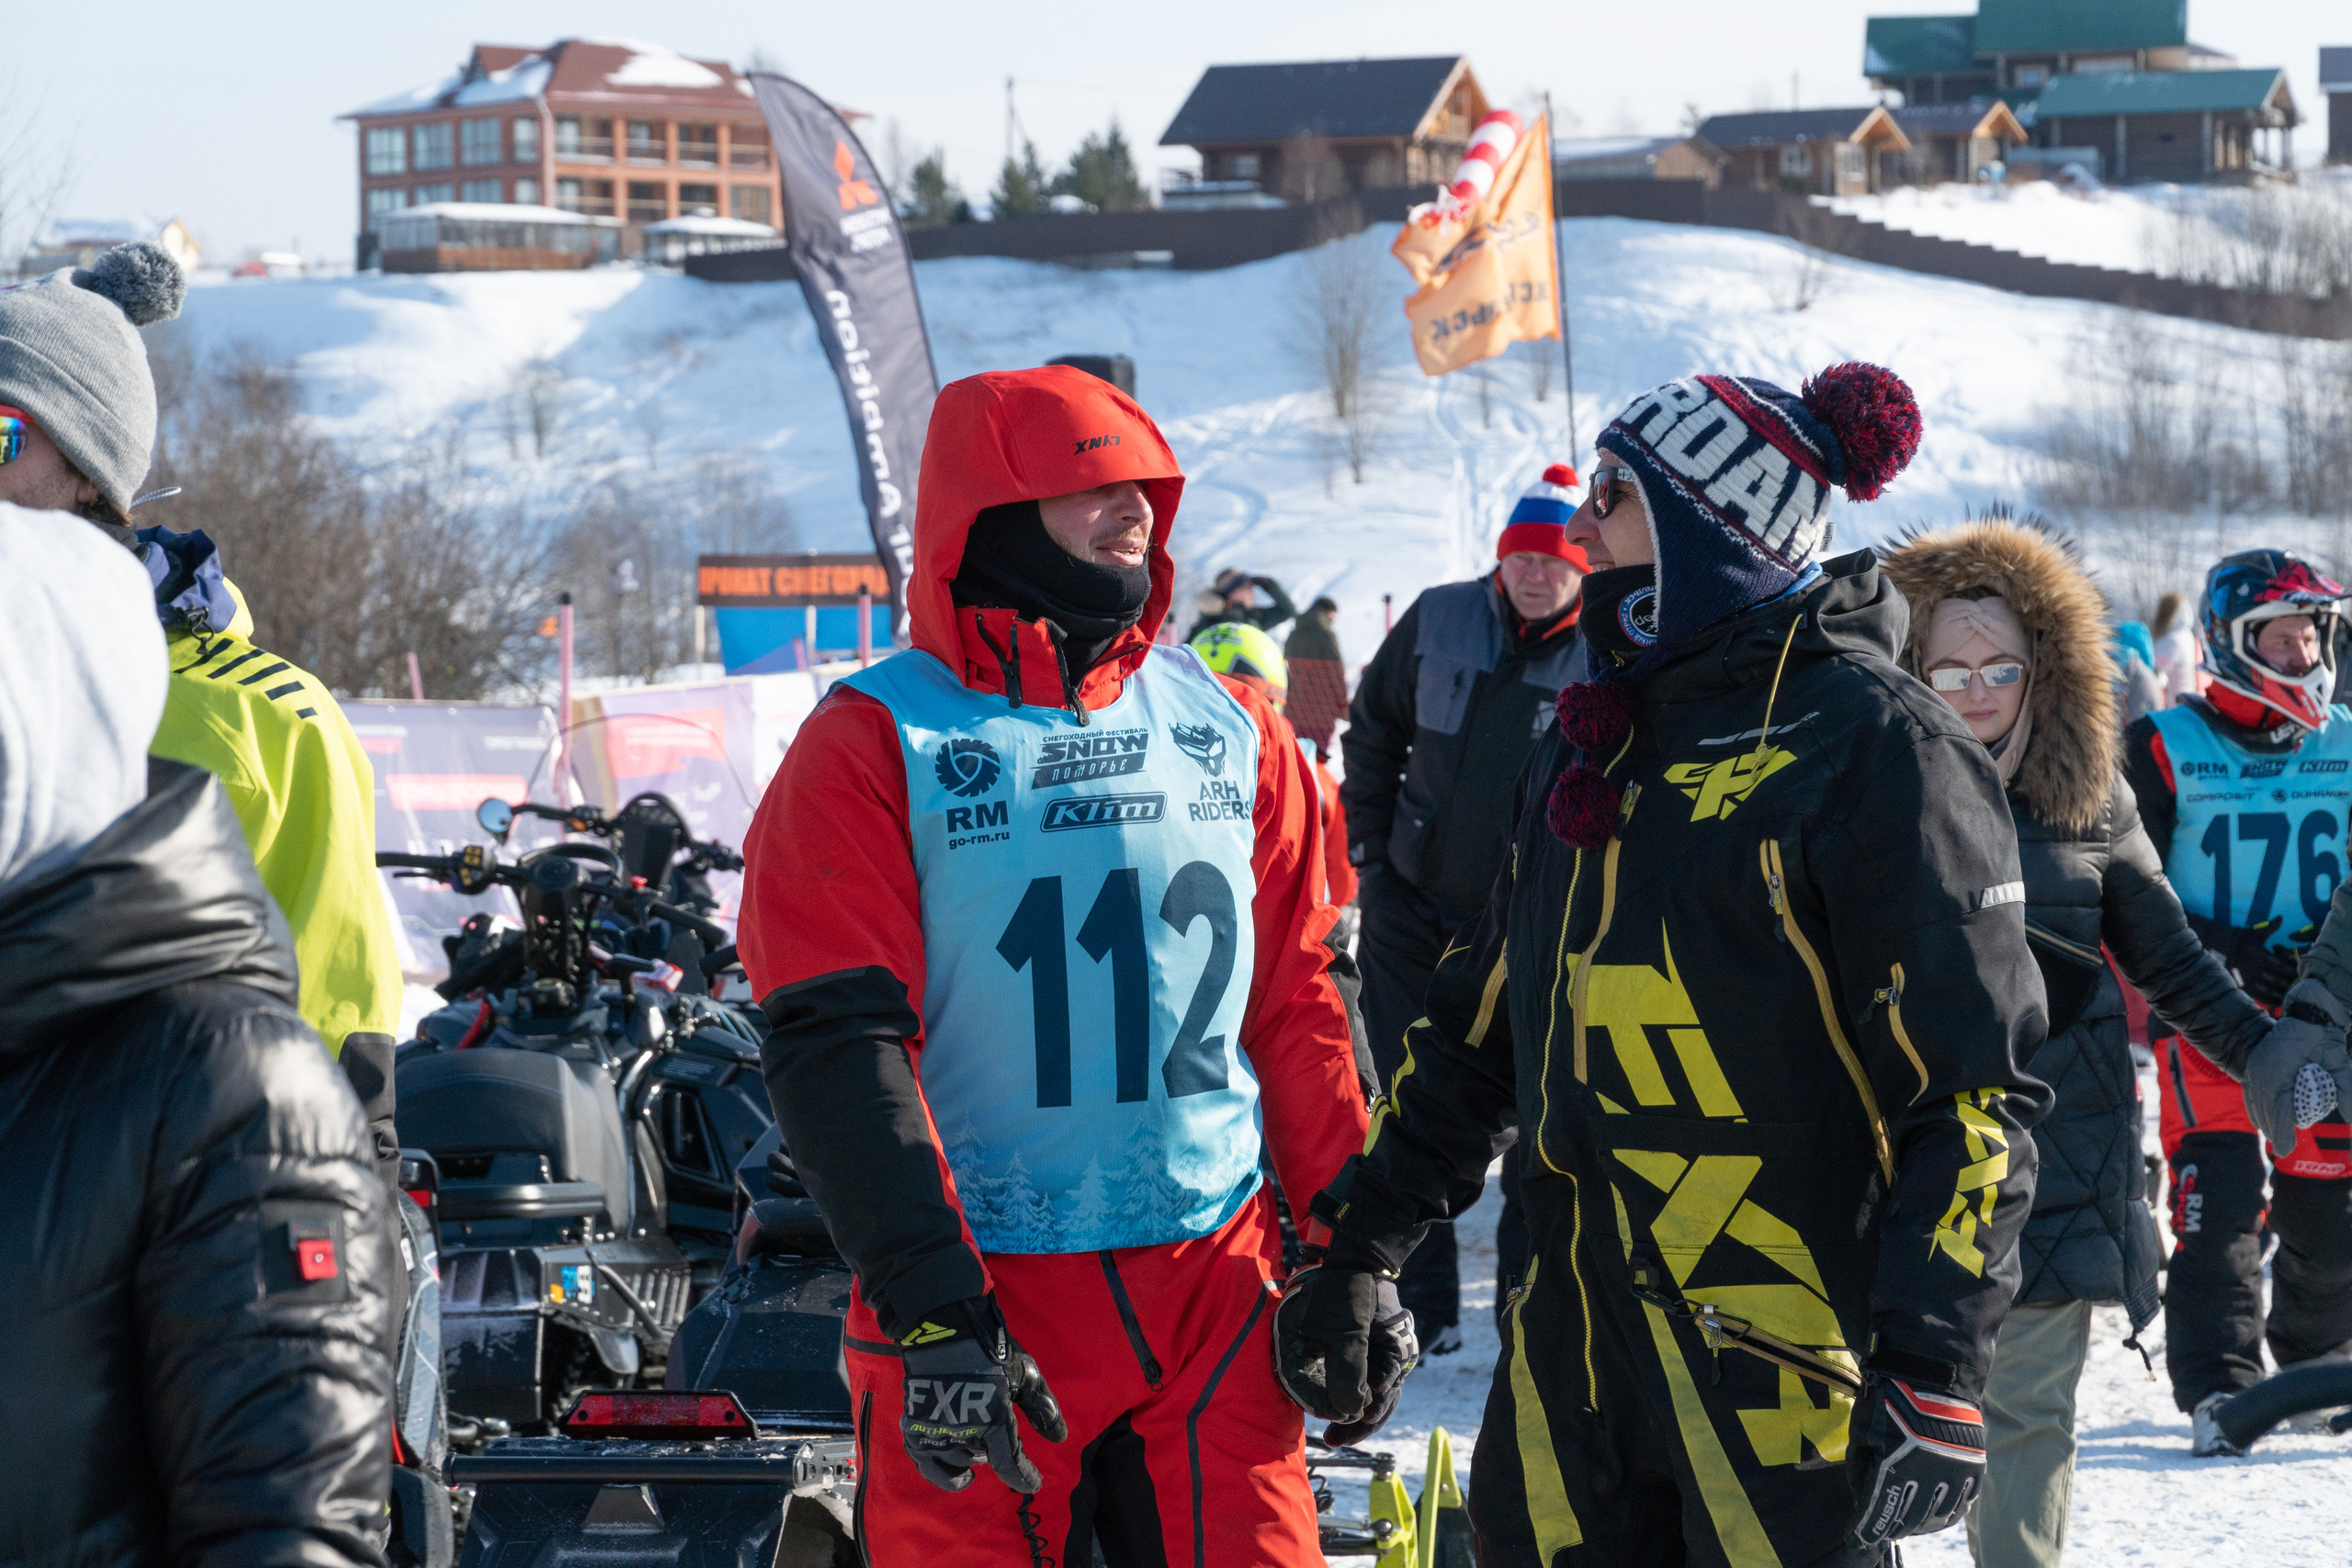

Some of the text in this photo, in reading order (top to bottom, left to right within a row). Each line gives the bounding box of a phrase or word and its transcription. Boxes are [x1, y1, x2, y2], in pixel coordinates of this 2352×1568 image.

[1073, 434, 1121, 456] LYNX
[1043, 728, 1148, 742] СНЕГОХОДНЫЙ ФЕСТИВАЛЬ
[1037, 733, 1148, 763] SNOW
[1052, 759, 1127, 781] ПОМОРЬЕ
[2198, 762, 2229, 774] RM
[1200, 781, 1240, 800] ARH
[946, 800, 1009, 833] RM
[1049, 800, 1158, 825] Klim
[1188, 800, 1250, 821] RIDERS
[949, 831, 1010, 850] go-rm.ru
[2201, 810, 2340, 927] 176
[995, 860, 1238, 1108] 112
[2185, 1193, 2203, 1233] RM
[908, 1379, 997, 1424] FXR
[910, 1424, 978, 1438] AUTHENTIC
[1872, 1485, 1902, 1536] reusch
